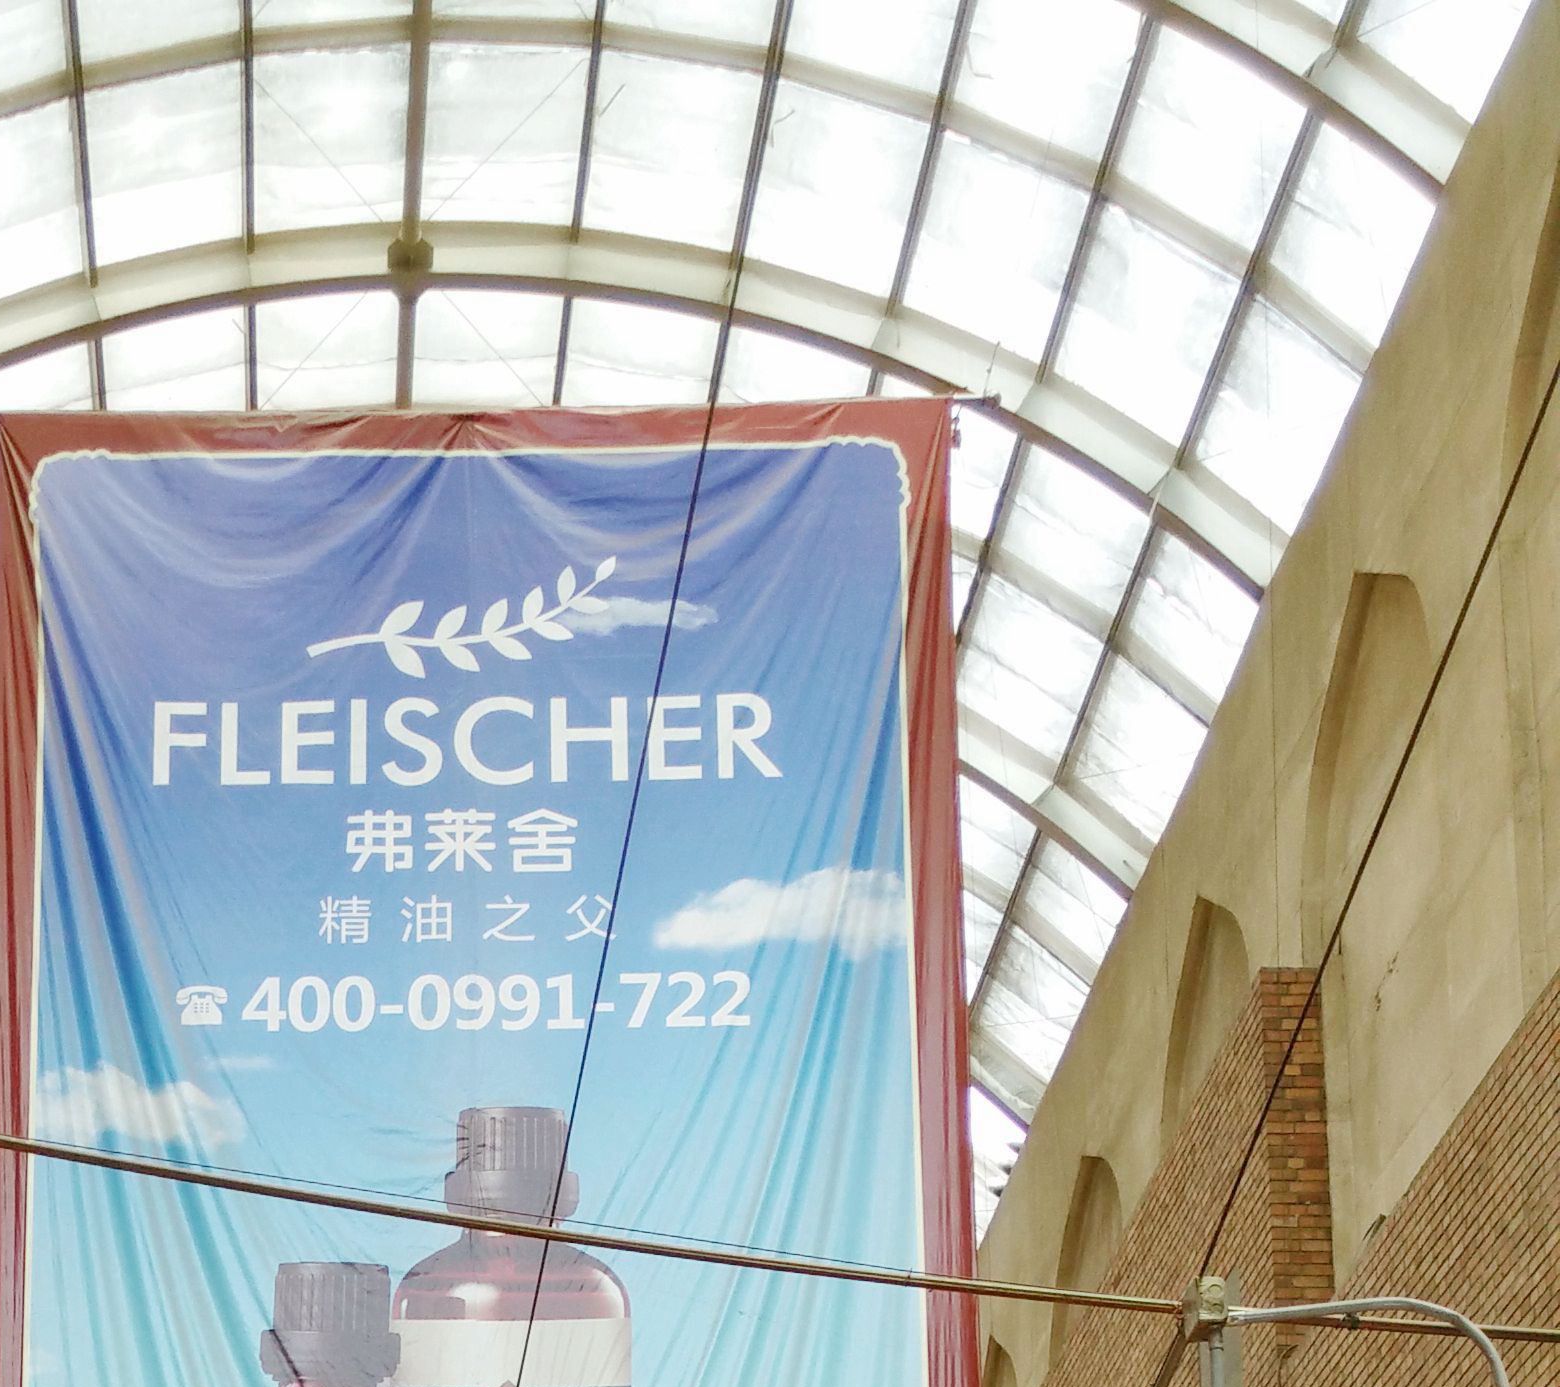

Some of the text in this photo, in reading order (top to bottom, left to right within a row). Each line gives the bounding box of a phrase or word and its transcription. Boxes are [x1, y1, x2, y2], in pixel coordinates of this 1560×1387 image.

[152, 691, 783, 787] FLEISCHER
[345, 806, 578, 874] 弗莱舍
[318, 894, 618, 945] 精油之父
[241, 971, 751, 1034] 400-0991-722
